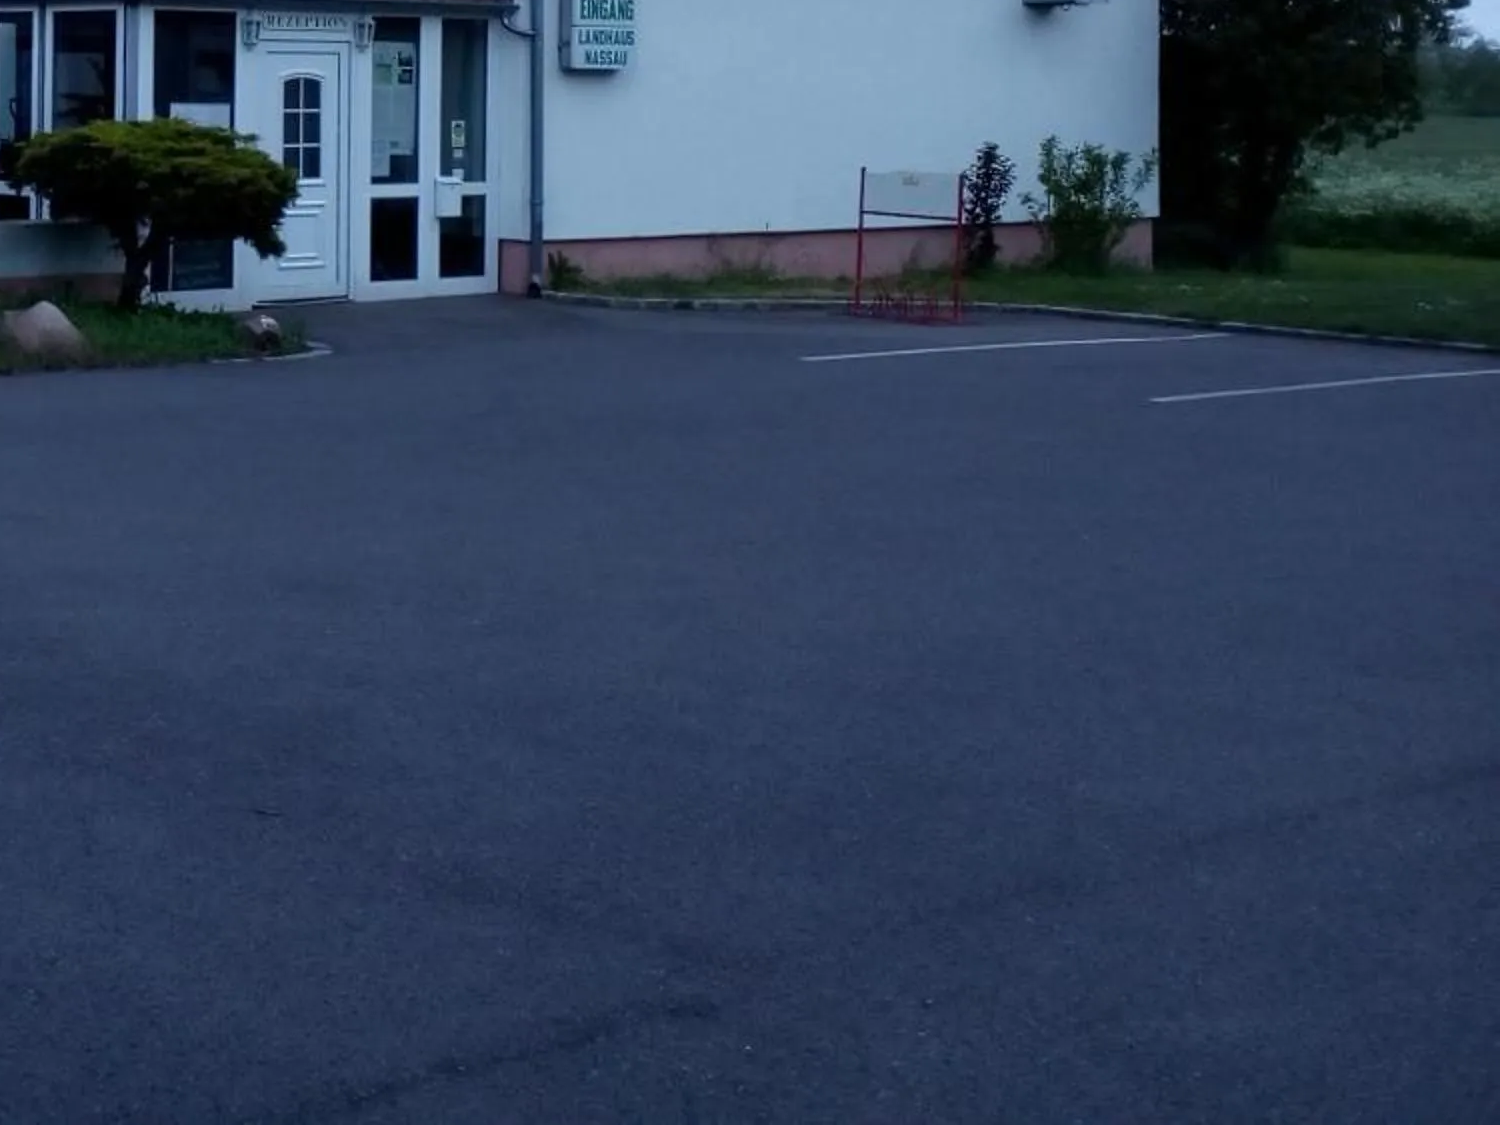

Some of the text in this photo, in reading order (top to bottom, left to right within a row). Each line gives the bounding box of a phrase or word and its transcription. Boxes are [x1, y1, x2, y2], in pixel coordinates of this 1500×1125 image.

[266, 14, 349, 28] REZEPTION
[579, 30, 636, 46] LANDHAUS
[584, 49, 628, 66] NASSAU
